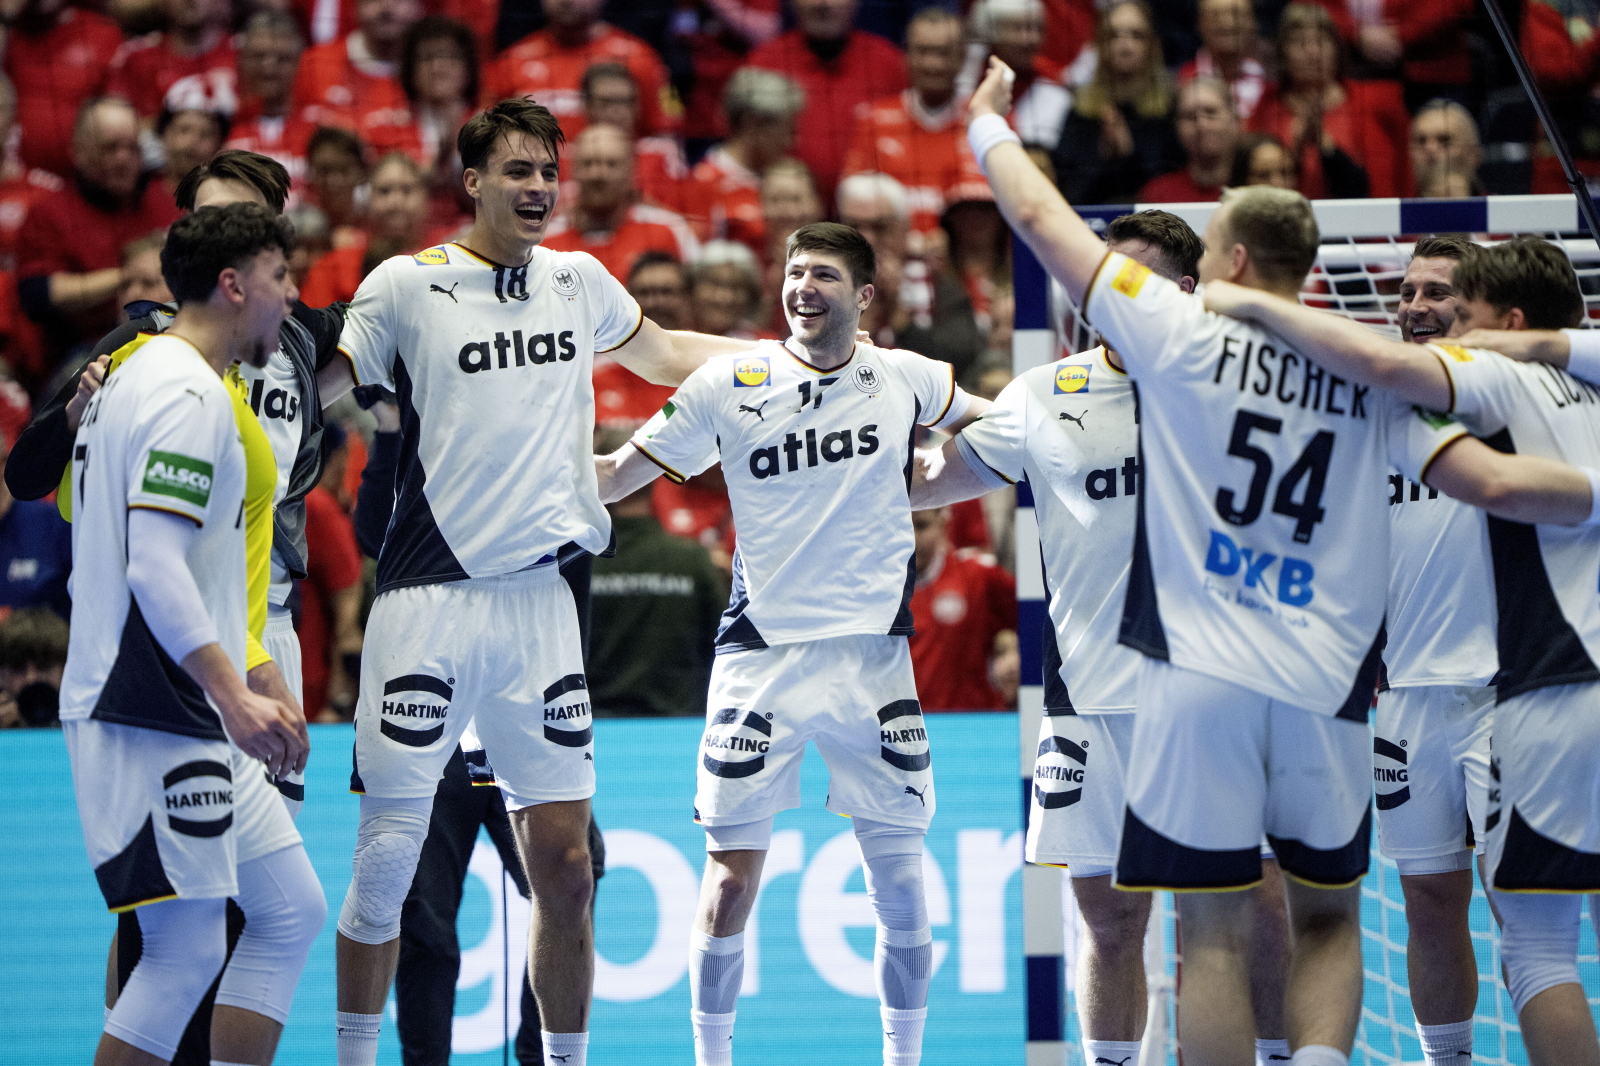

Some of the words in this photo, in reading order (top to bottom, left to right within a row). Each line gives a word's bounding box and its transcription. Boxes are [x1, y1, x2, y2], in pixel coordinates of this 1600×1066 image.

[492, 265, 530, 303] 18
[458, 330, 576, 374] atlas
[250, 378, 298, 422] las
[749, 424, 879, 479] atlas
[147, 461, 211, 490] ALSCO
[1215, 408, 1335, 545] 54
[1205, 529, 1315, 608] DKB
[382, 700, 448, 719] HARTING
[705, 734, 770, 754] HARTING
[1035, 765, 1085, 783] HARTING
[1374, 767, 1408, 782] TING
